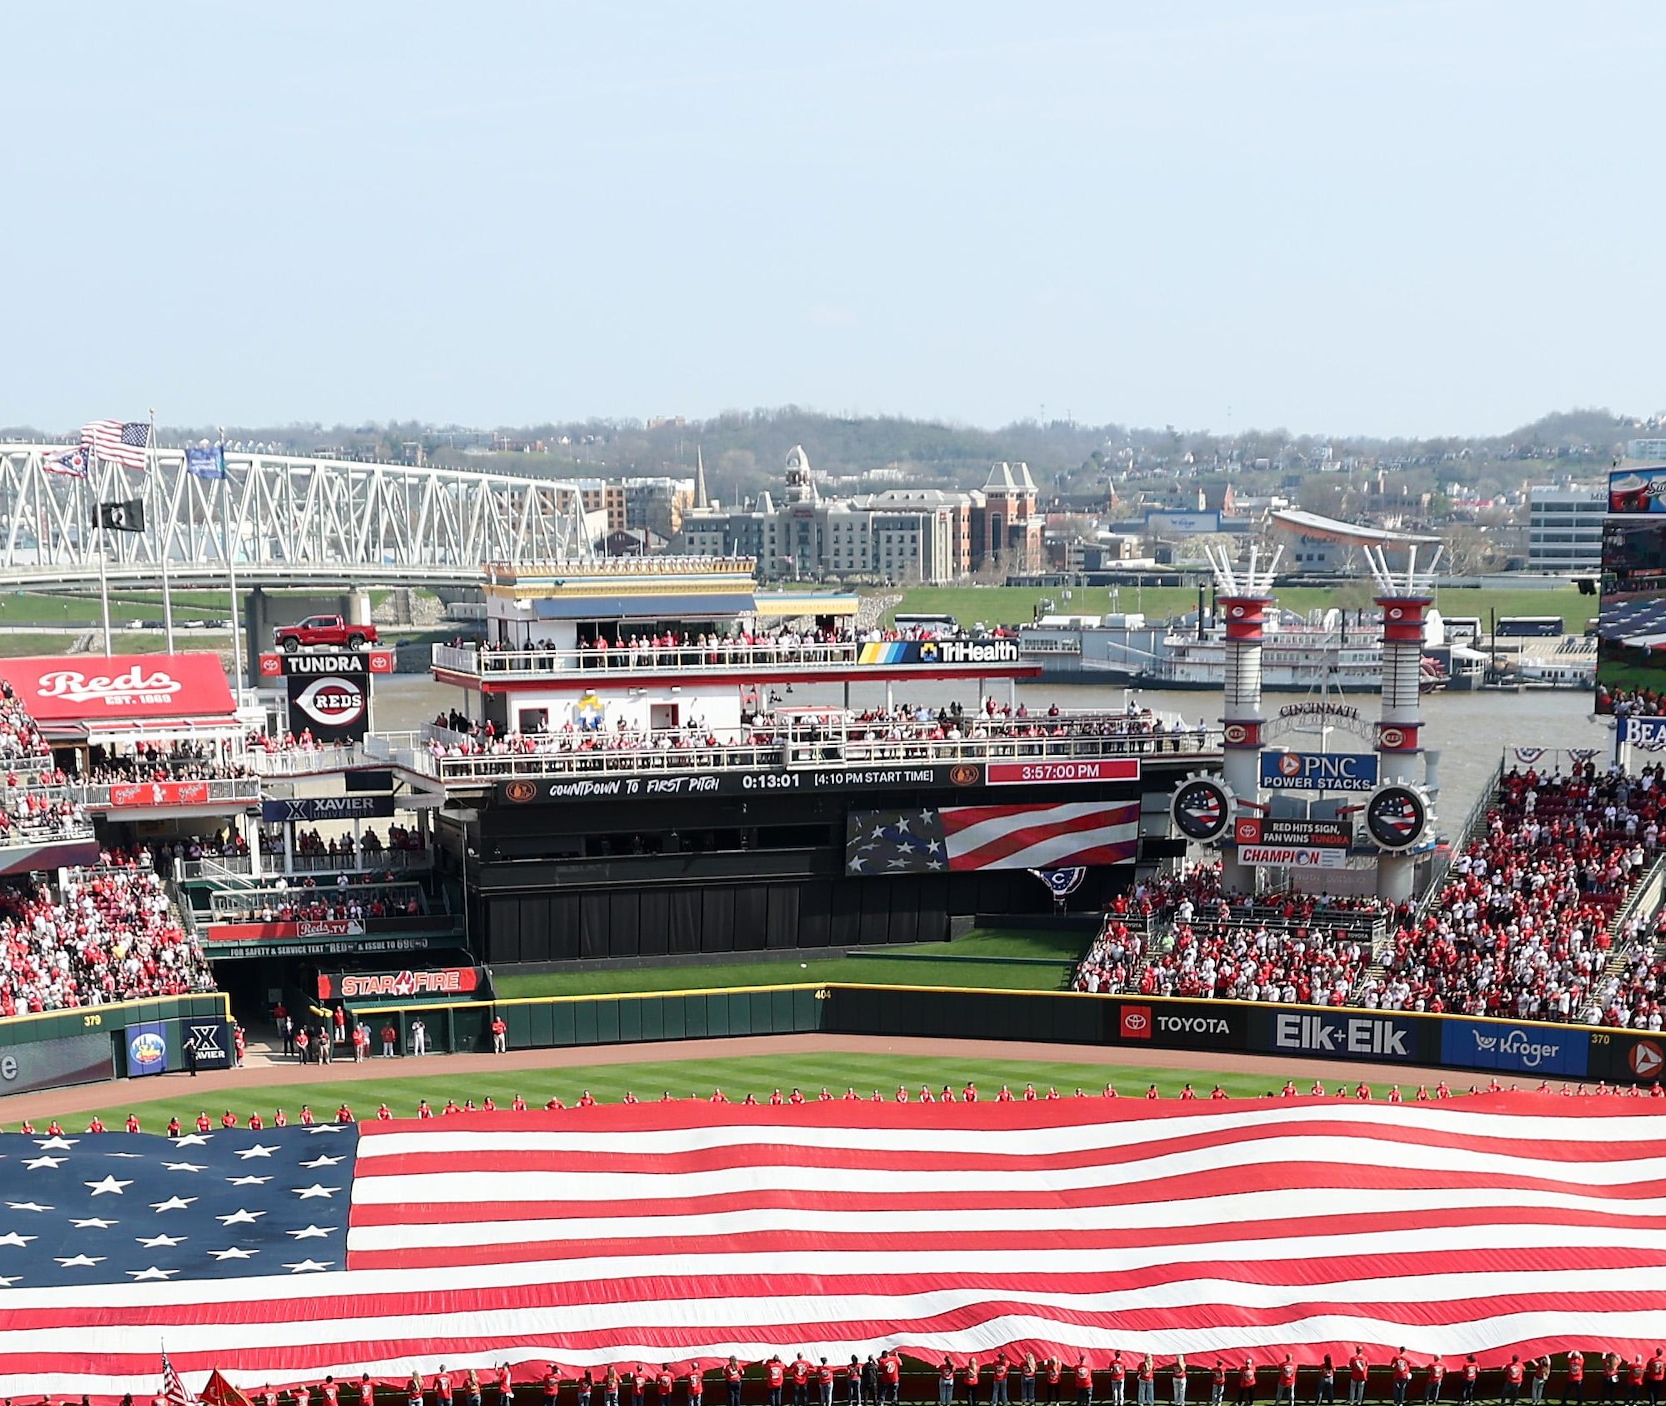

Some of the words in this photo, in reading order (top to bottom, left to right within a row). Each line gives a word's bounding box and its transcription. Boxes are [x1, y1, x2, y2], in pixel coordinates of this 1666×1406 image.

[938, 641, 1017, 662] TriHealth
[288, 655, 363, 673] TUNDRA
[37, 665, 182, 703] Reds
[316, 694, 362, 709] REDS
[1279, 702, 1359, 718] CINCINNATI
[1021, 765, 1075, 780] 3:57:00
[1078, 764, 1100, 778] PM
[1303, 757, 1357, 778] PNC
[549, 780, 620, 797] COUNTDOWN
[626, 780, 639, 793] TO
[647, 777, 688, 793] FIRST
[688, 776, 720, 791] PITCH
[742, 774, 800, 789] 0:13:01
[846, 772, 863, 784] PM
[865, 771, 899, 783] START
[1264, 776, 1312, 788] POWER
[1318, 777, 1371, 790] STACKS
[315, 798, 374, 811] XAVIER
[1273, 823, 1293, 832] RED
[1293, 823, 1313, 833] HITS
[1263, 832, 1283, 843] FAN
[1284, 833, 1309, 843] WINS
[231, 949, 244, 957] FOR
[245, 947, 270, 956] SAFETY
[278, 945, 305, 955] SERVICE
[306, 944, 324, 954] TEXT
[342, 976, 394, 996] STAR
[413, 971, 461, 993] FIRE
[814, 989, 832, 1000] 404
[84, 1015, 101, 1027] 379
[1157, 1016, 1230, 1035] TOYOTA
[1591, 1034, 1610, 1045] 370
[1500, 1030, 1559, 1066] Kroger
